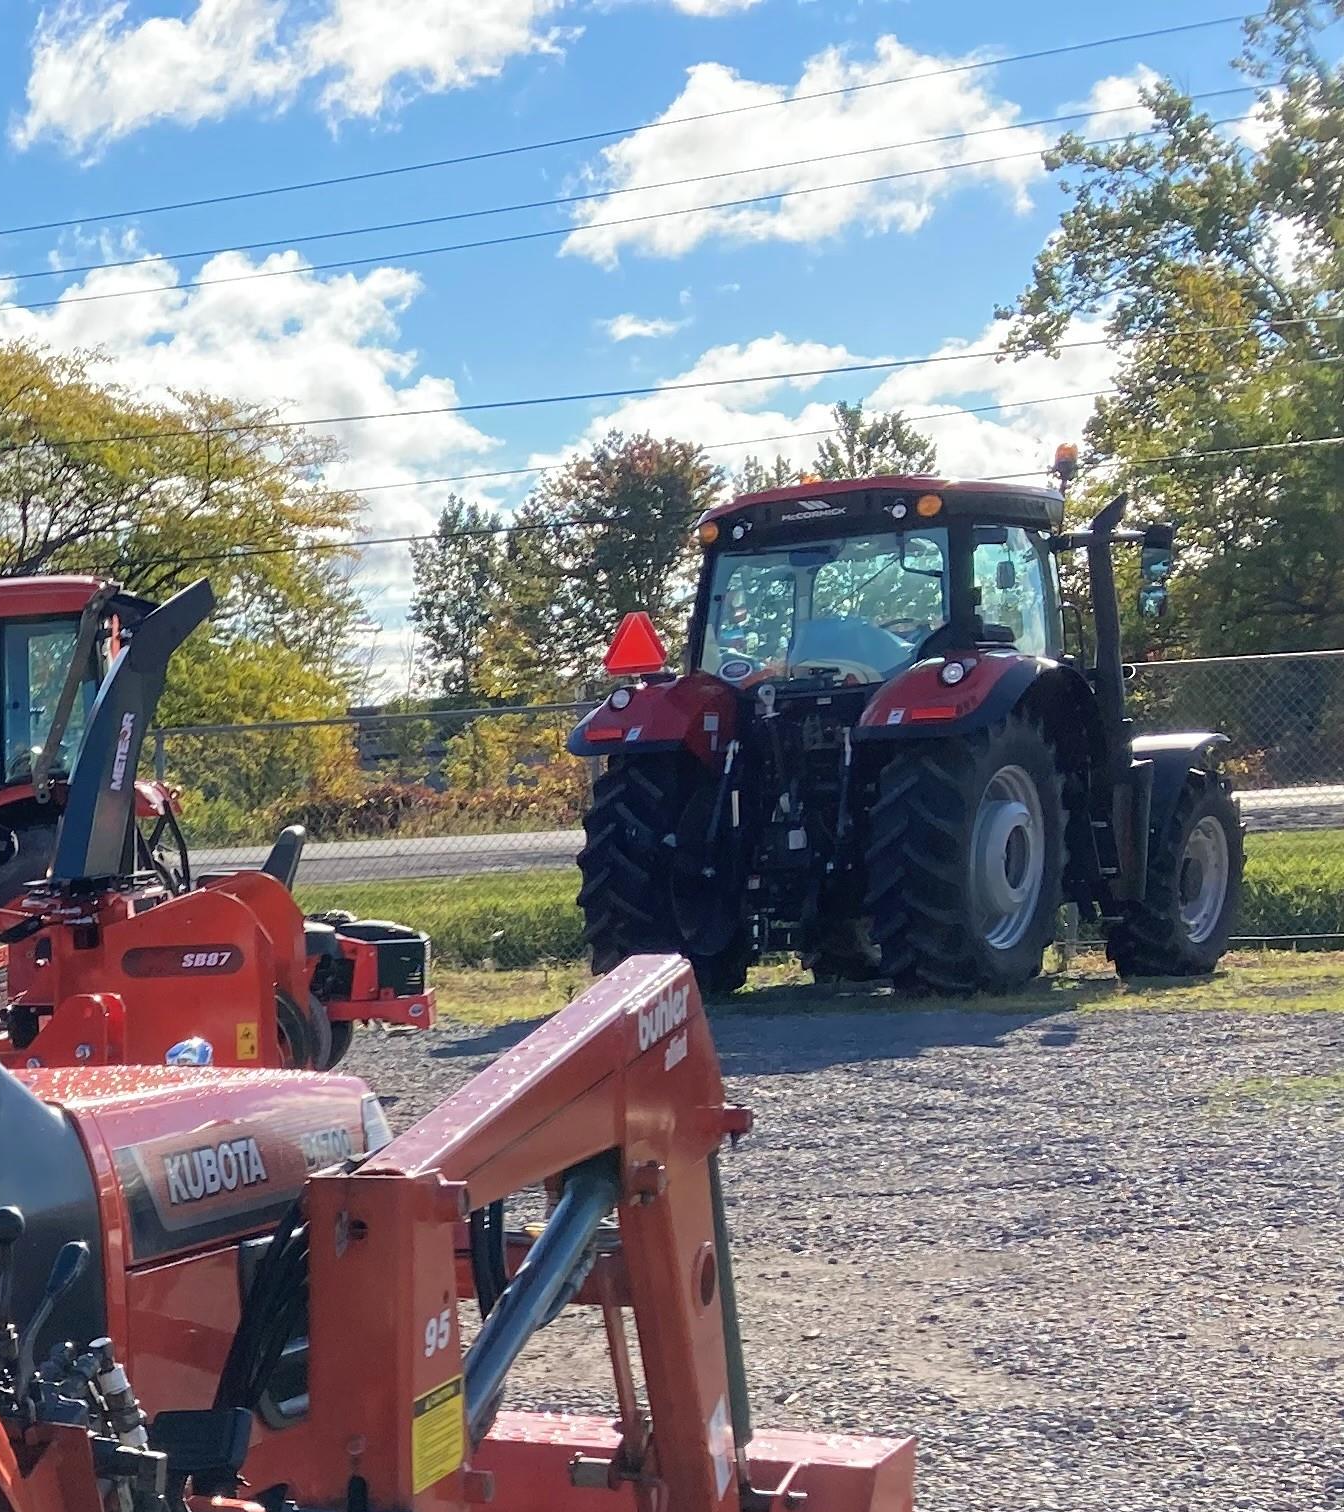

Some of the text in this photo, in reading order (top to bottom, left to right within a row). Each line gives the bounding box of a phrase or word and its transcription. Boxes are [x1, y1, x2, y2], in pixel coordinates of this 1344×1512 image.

[110, 712, 136, 791] METEOR
[181, 951, 232, 968] SB87
[164, 1137, 267, 1204] KUBOTA
[425, 1309, 451, 1358] 95
